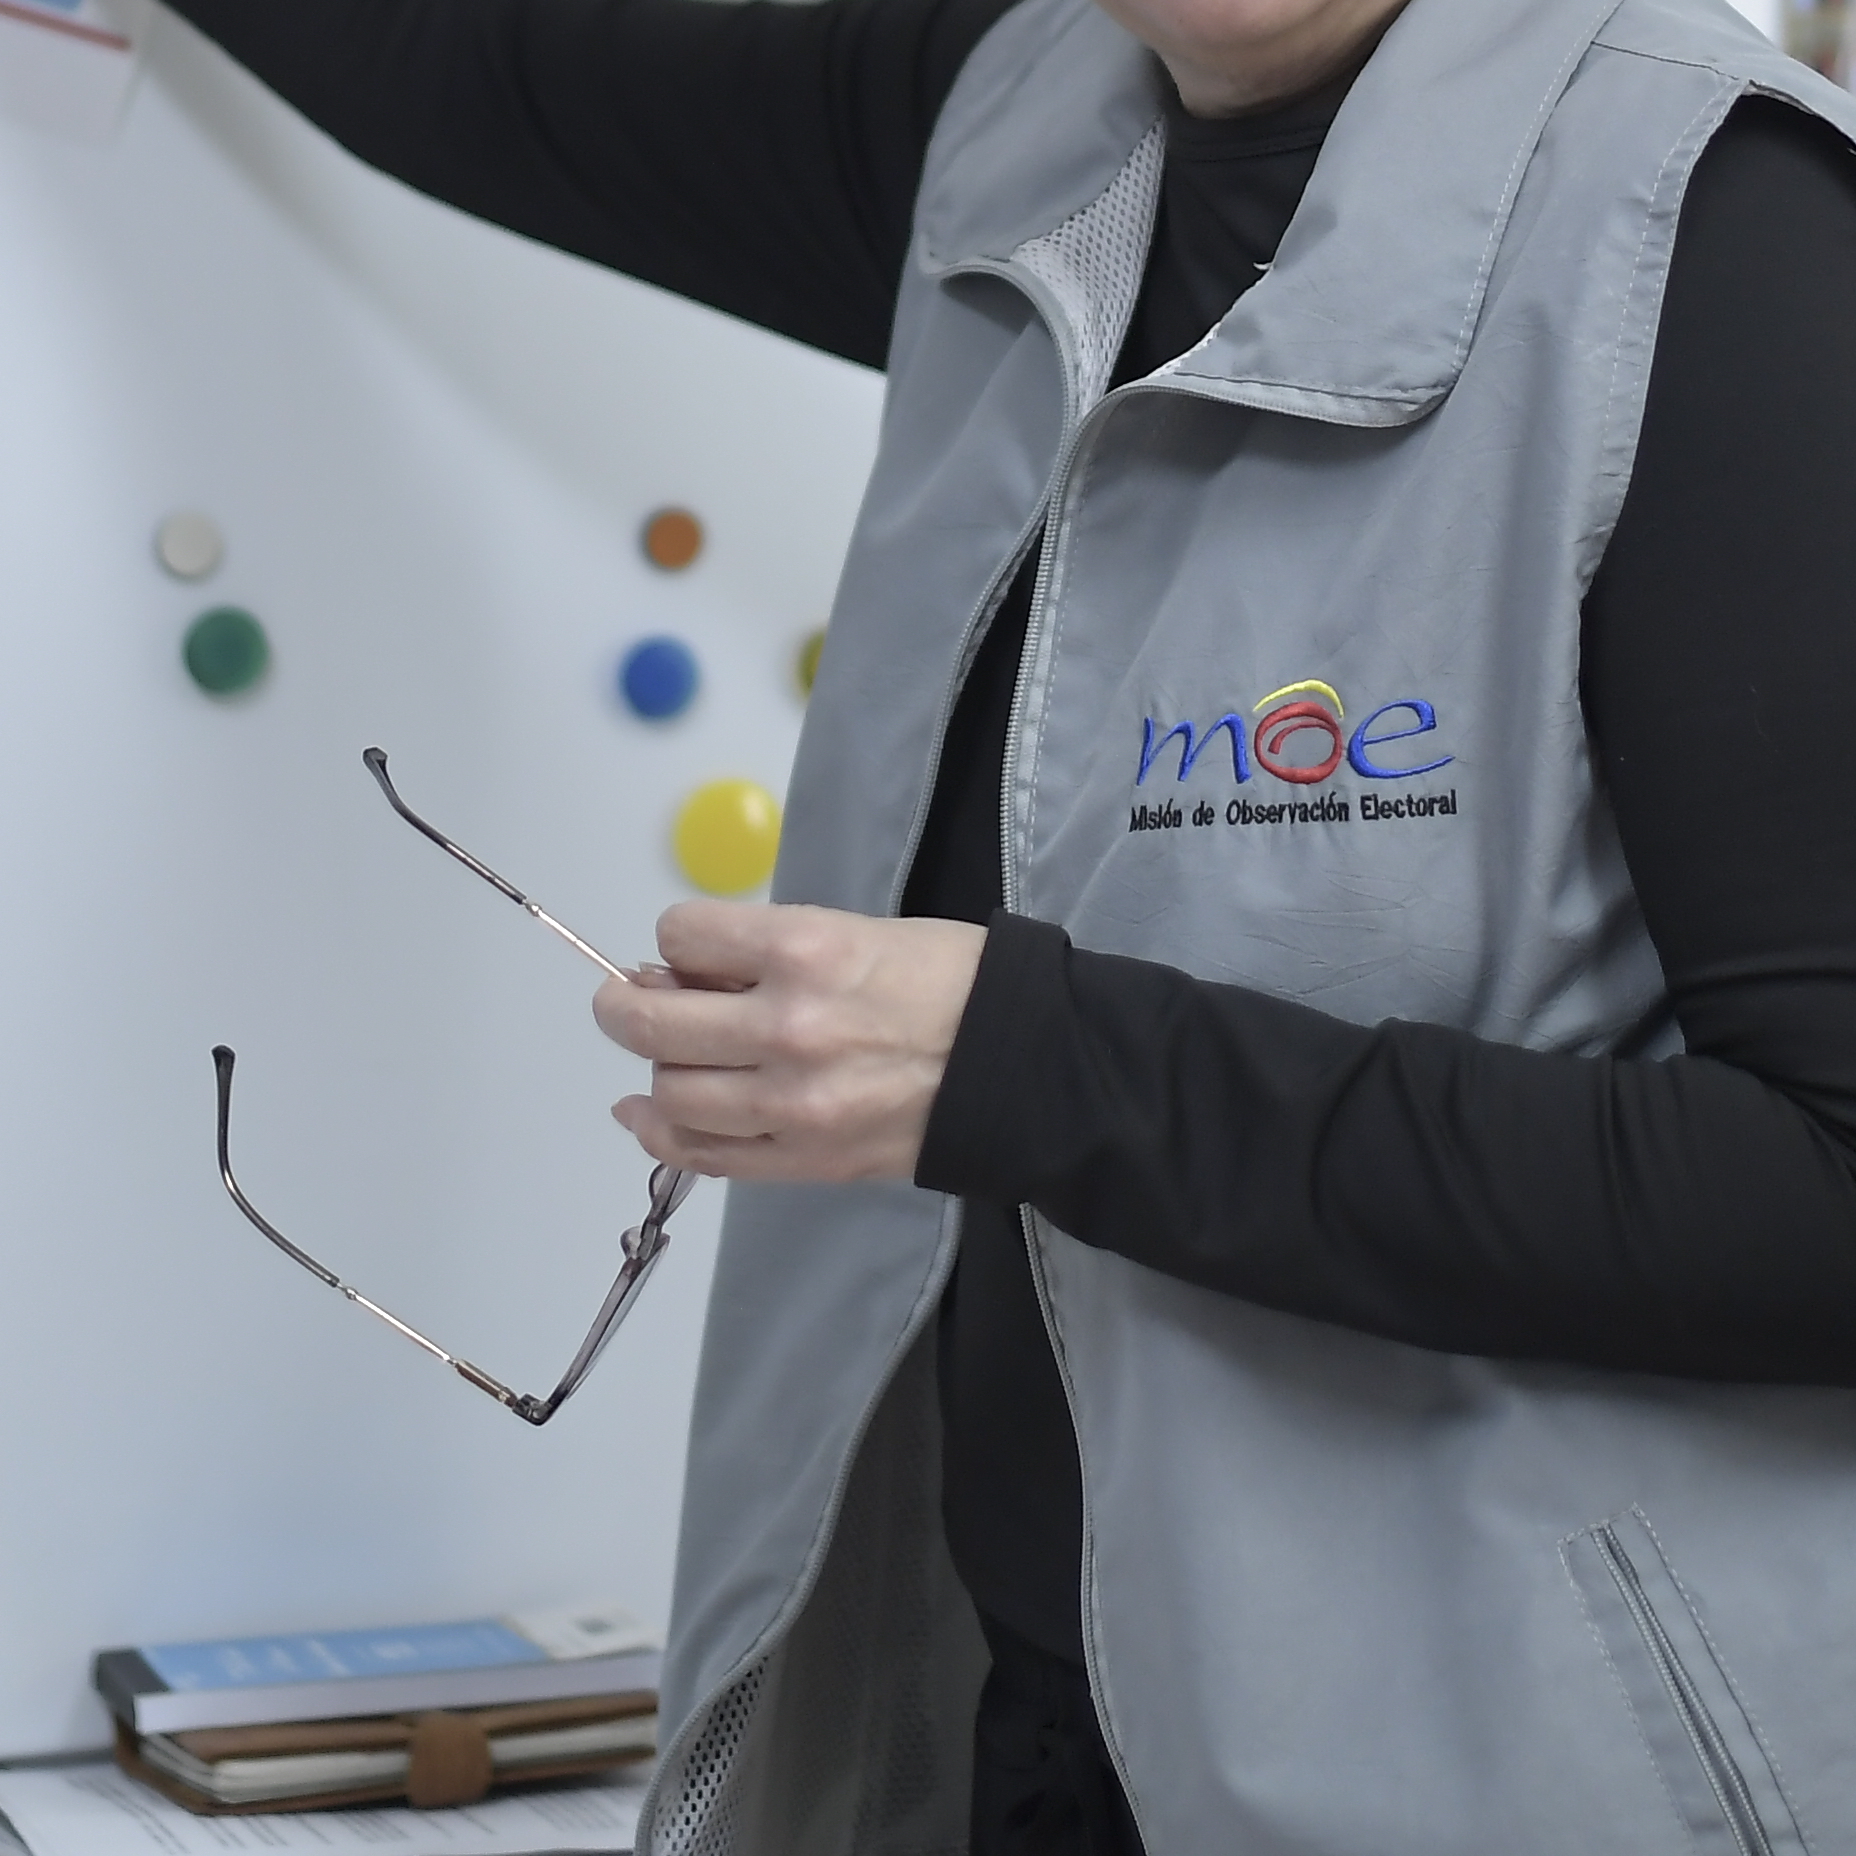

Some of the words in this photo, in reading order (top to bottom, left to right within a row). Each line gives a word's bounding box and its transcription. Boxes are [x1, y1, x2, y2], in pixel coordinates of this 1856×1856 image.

[1135, 697, 1456, 786] moe
[1128, 798, 1183, 832] Misión
[1191, 800, 1215, 827] de
[1226, 790, 1349, 825] Observación
[1359, 789, 1457, 821] Electoral
